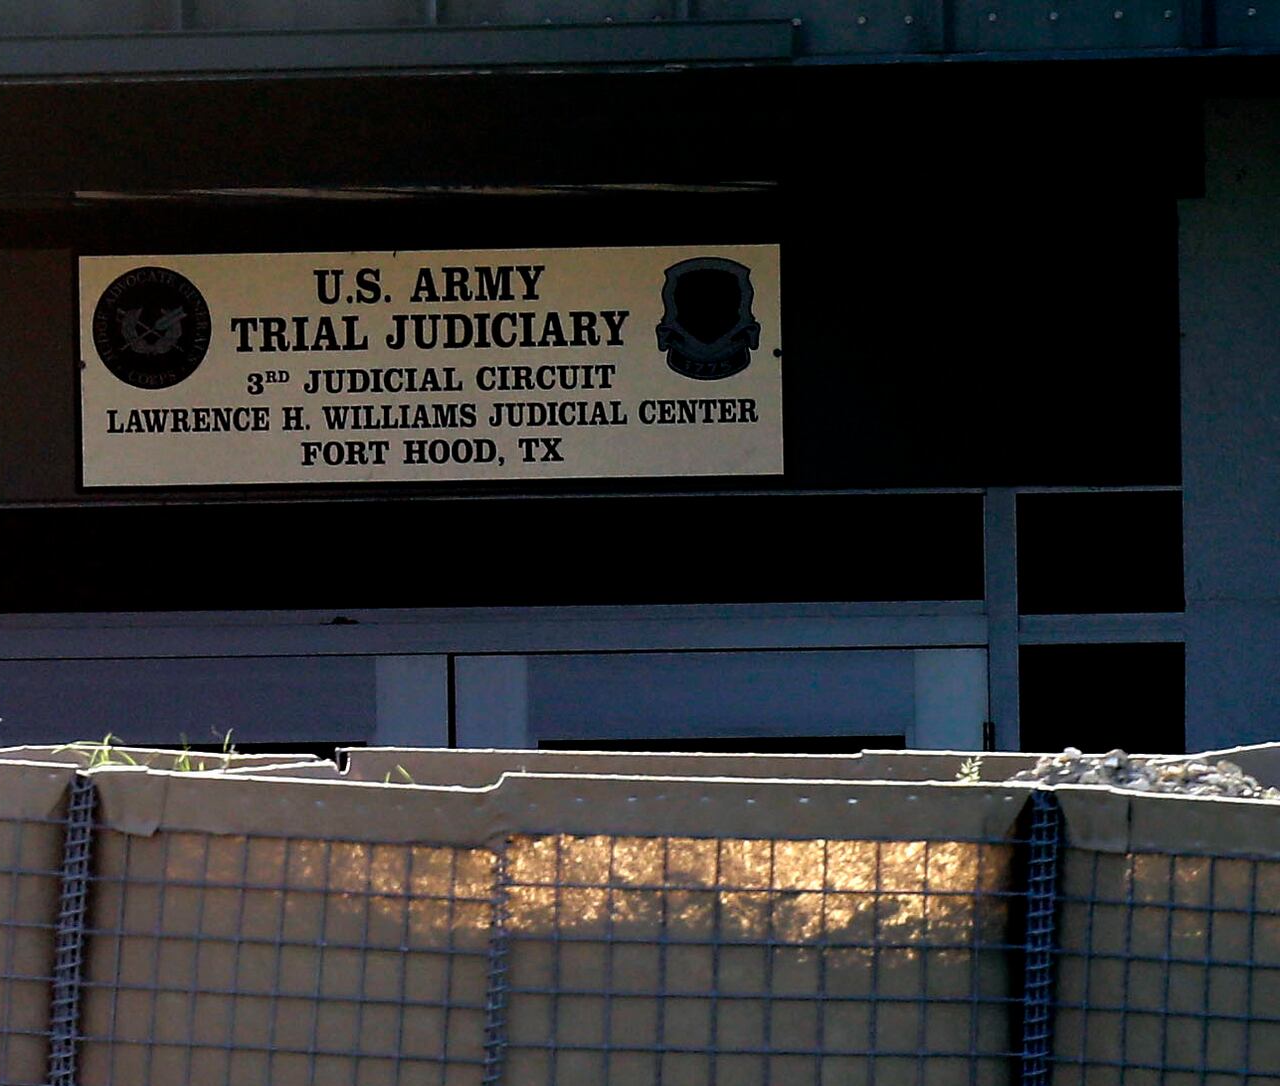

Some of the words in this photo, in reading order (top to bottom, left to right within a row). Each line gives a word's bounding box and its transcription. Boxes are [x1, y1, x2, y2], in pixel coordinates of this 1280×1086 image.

[313, 267, 392, 304] U.S.
[409, 264, 545, 303] ARMY
[230, 315, 369, 353] TRIAL
[385, 310, 630, 351] JUDICIARY
[246, 370, 290, 395] 3RD
[303, 367, 463, 394] JUDICIAL
[475, 364, 615, 392] CIRCUIT
[106, 406, 270, 433] LAWRENCE
[281, 406, 311, 431] H.
[321, 403, 477, 430] WILLIAMS
[488, 400, 628, 427] JUDICIAL
[638, 398, 759, 424] CENTER
[300, 440, 390, 466] FORT
[402, 438, 505, 467] HOOD,
[518, 437, 565, 463] TX
